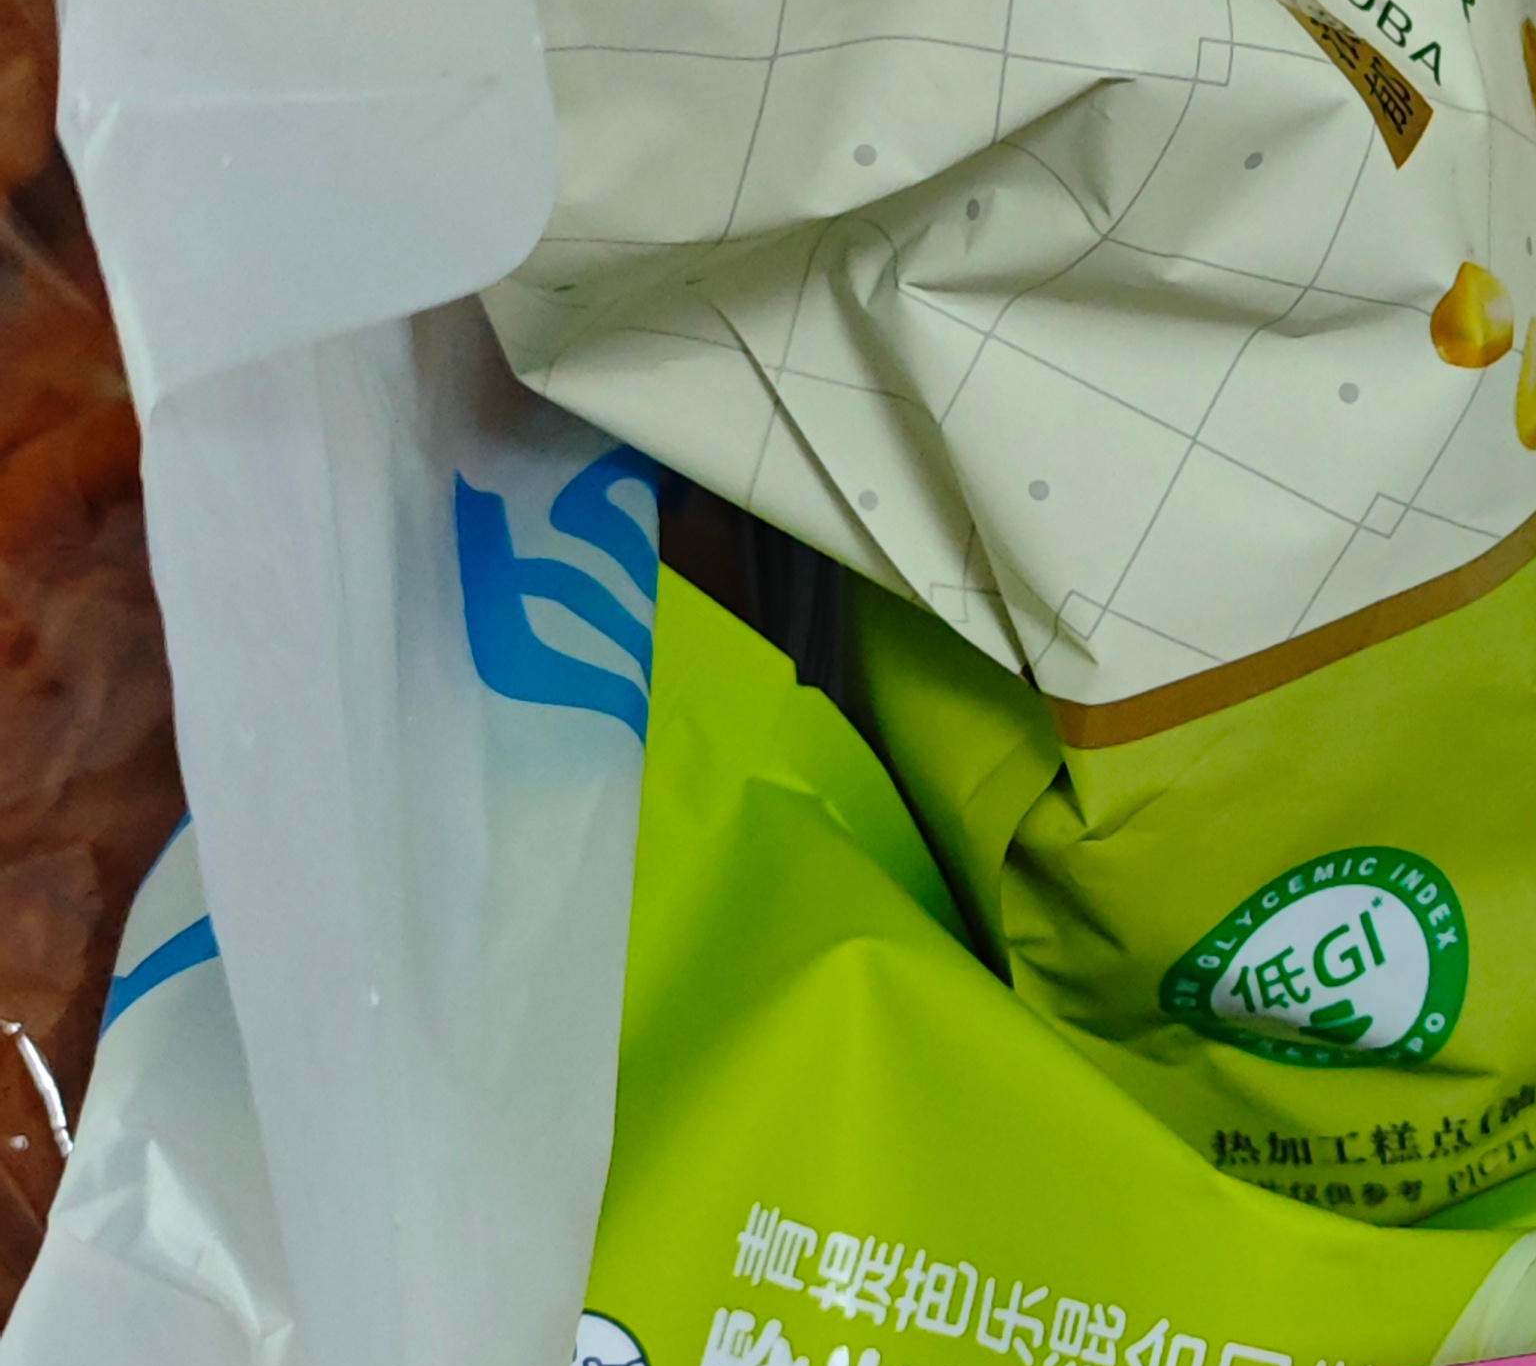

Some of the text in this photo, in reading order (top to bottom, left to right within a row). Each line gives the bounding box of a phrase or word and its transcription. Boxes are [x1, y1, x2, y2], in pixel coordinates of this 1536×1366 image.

[1196, 856, 1459, 970] GLYCEMIC INDEX
[1229, 910, 1387, 1014] 低GI
